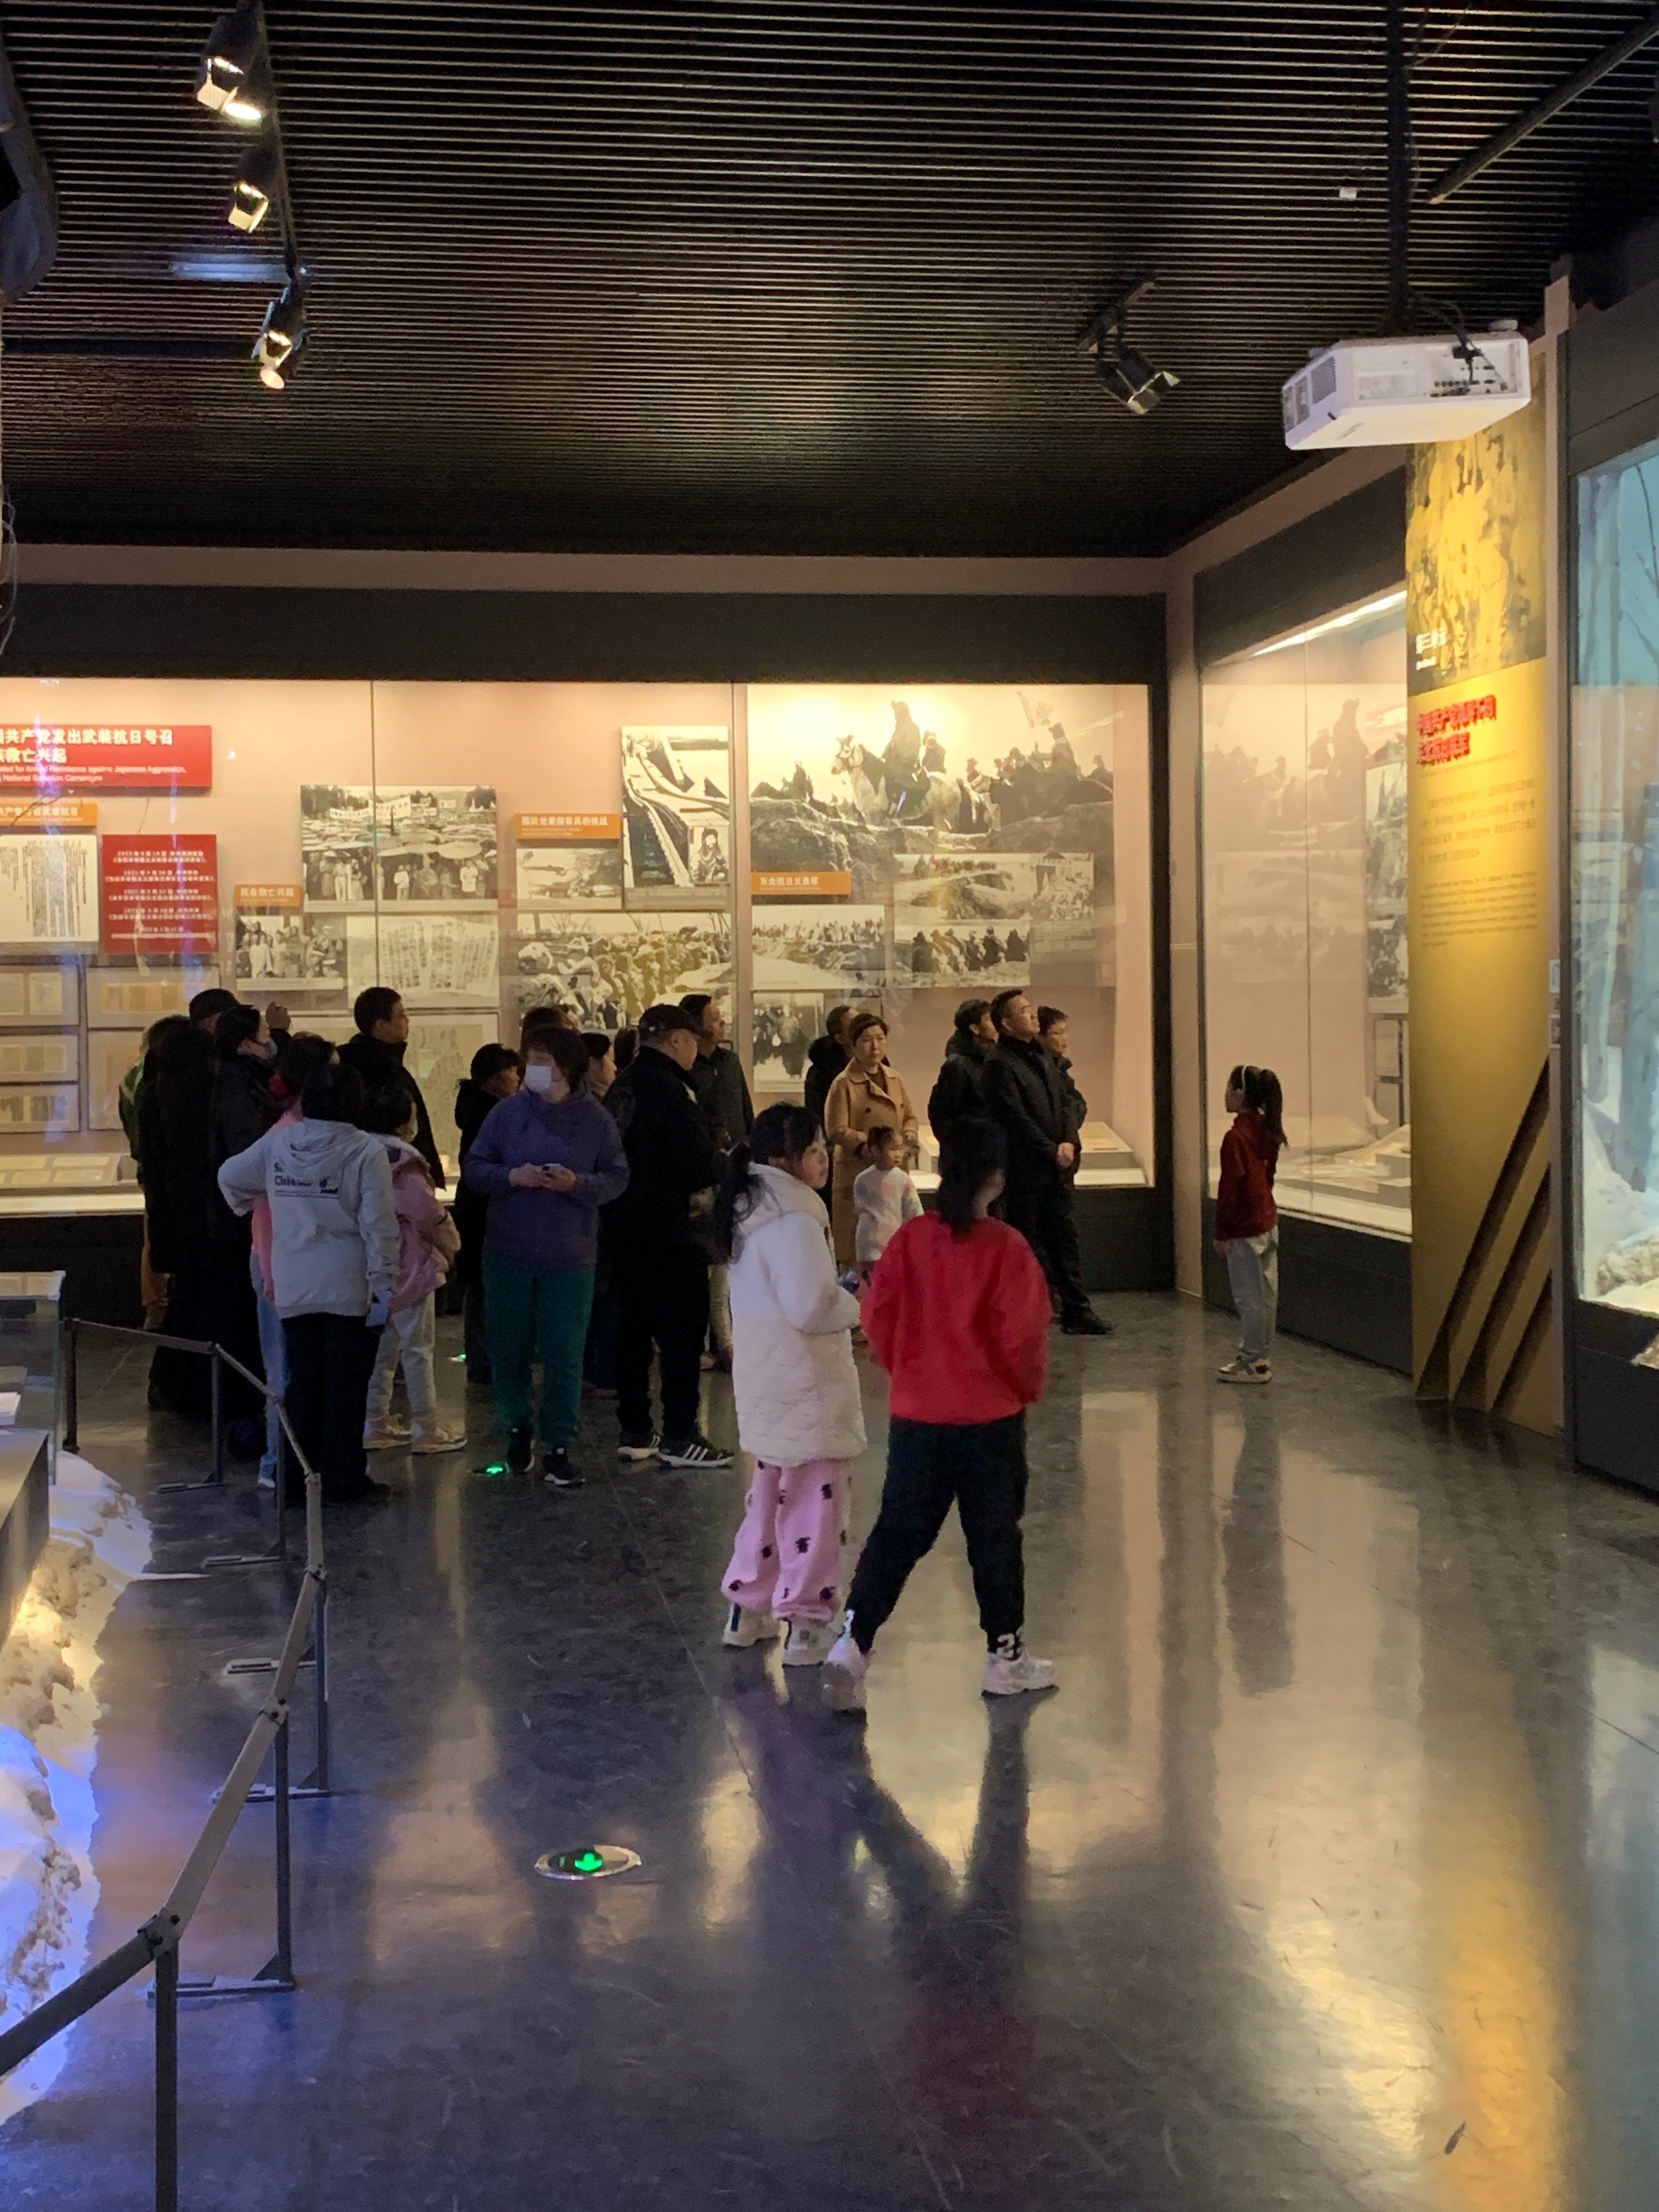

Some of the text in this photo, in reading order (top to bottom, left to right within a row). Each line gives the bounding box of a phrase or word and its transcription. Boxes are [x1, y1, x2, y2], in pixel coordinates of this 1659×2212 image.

[0, 728, 173, 745] 共产党发出武装抗日号召
